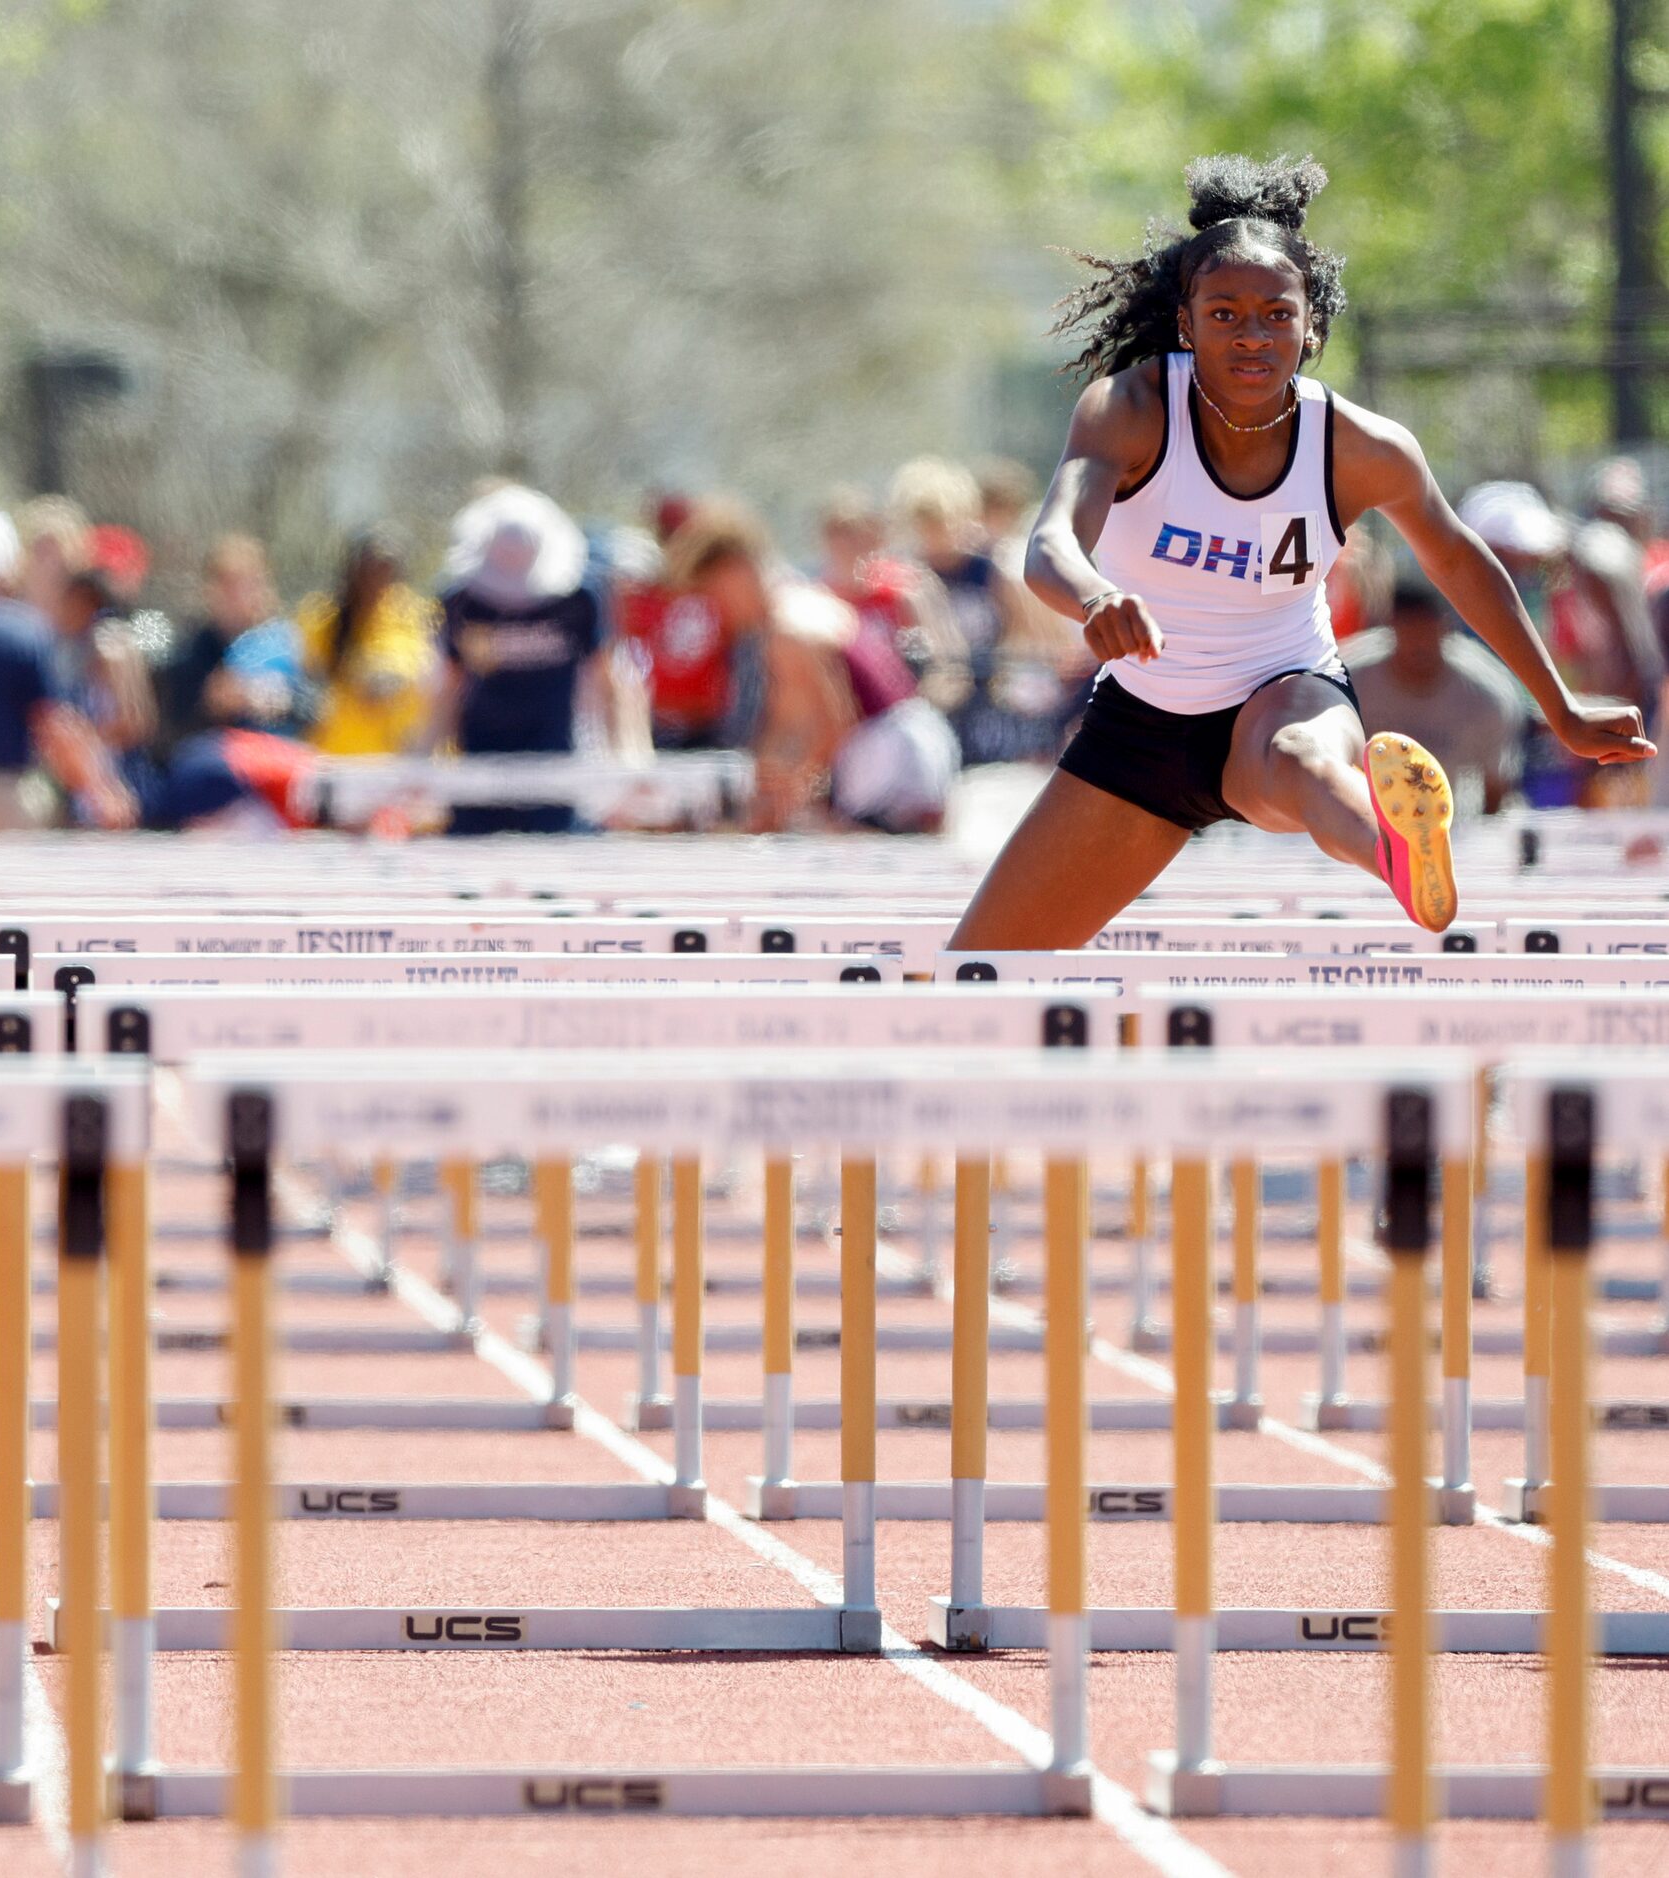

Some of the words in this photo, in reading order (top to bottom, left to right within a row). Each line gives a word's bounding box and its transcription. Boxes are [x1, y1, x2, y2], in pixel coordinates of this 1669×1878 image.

[1268, 517, 1314, 586] 4
[57, 939, 138, 953] UCS
[563, 940, 646, 953] UCS
[821, 940, 904, 954] UCS
[1248, 1017, 1364, 1045] UCS
[299, 1490, 400, 1513] UCS
[1090, 1491, 1166, 1513] CS
[405, 1615, 523, 1642] UCS
[522, 1779, 664, 1811] UCS
